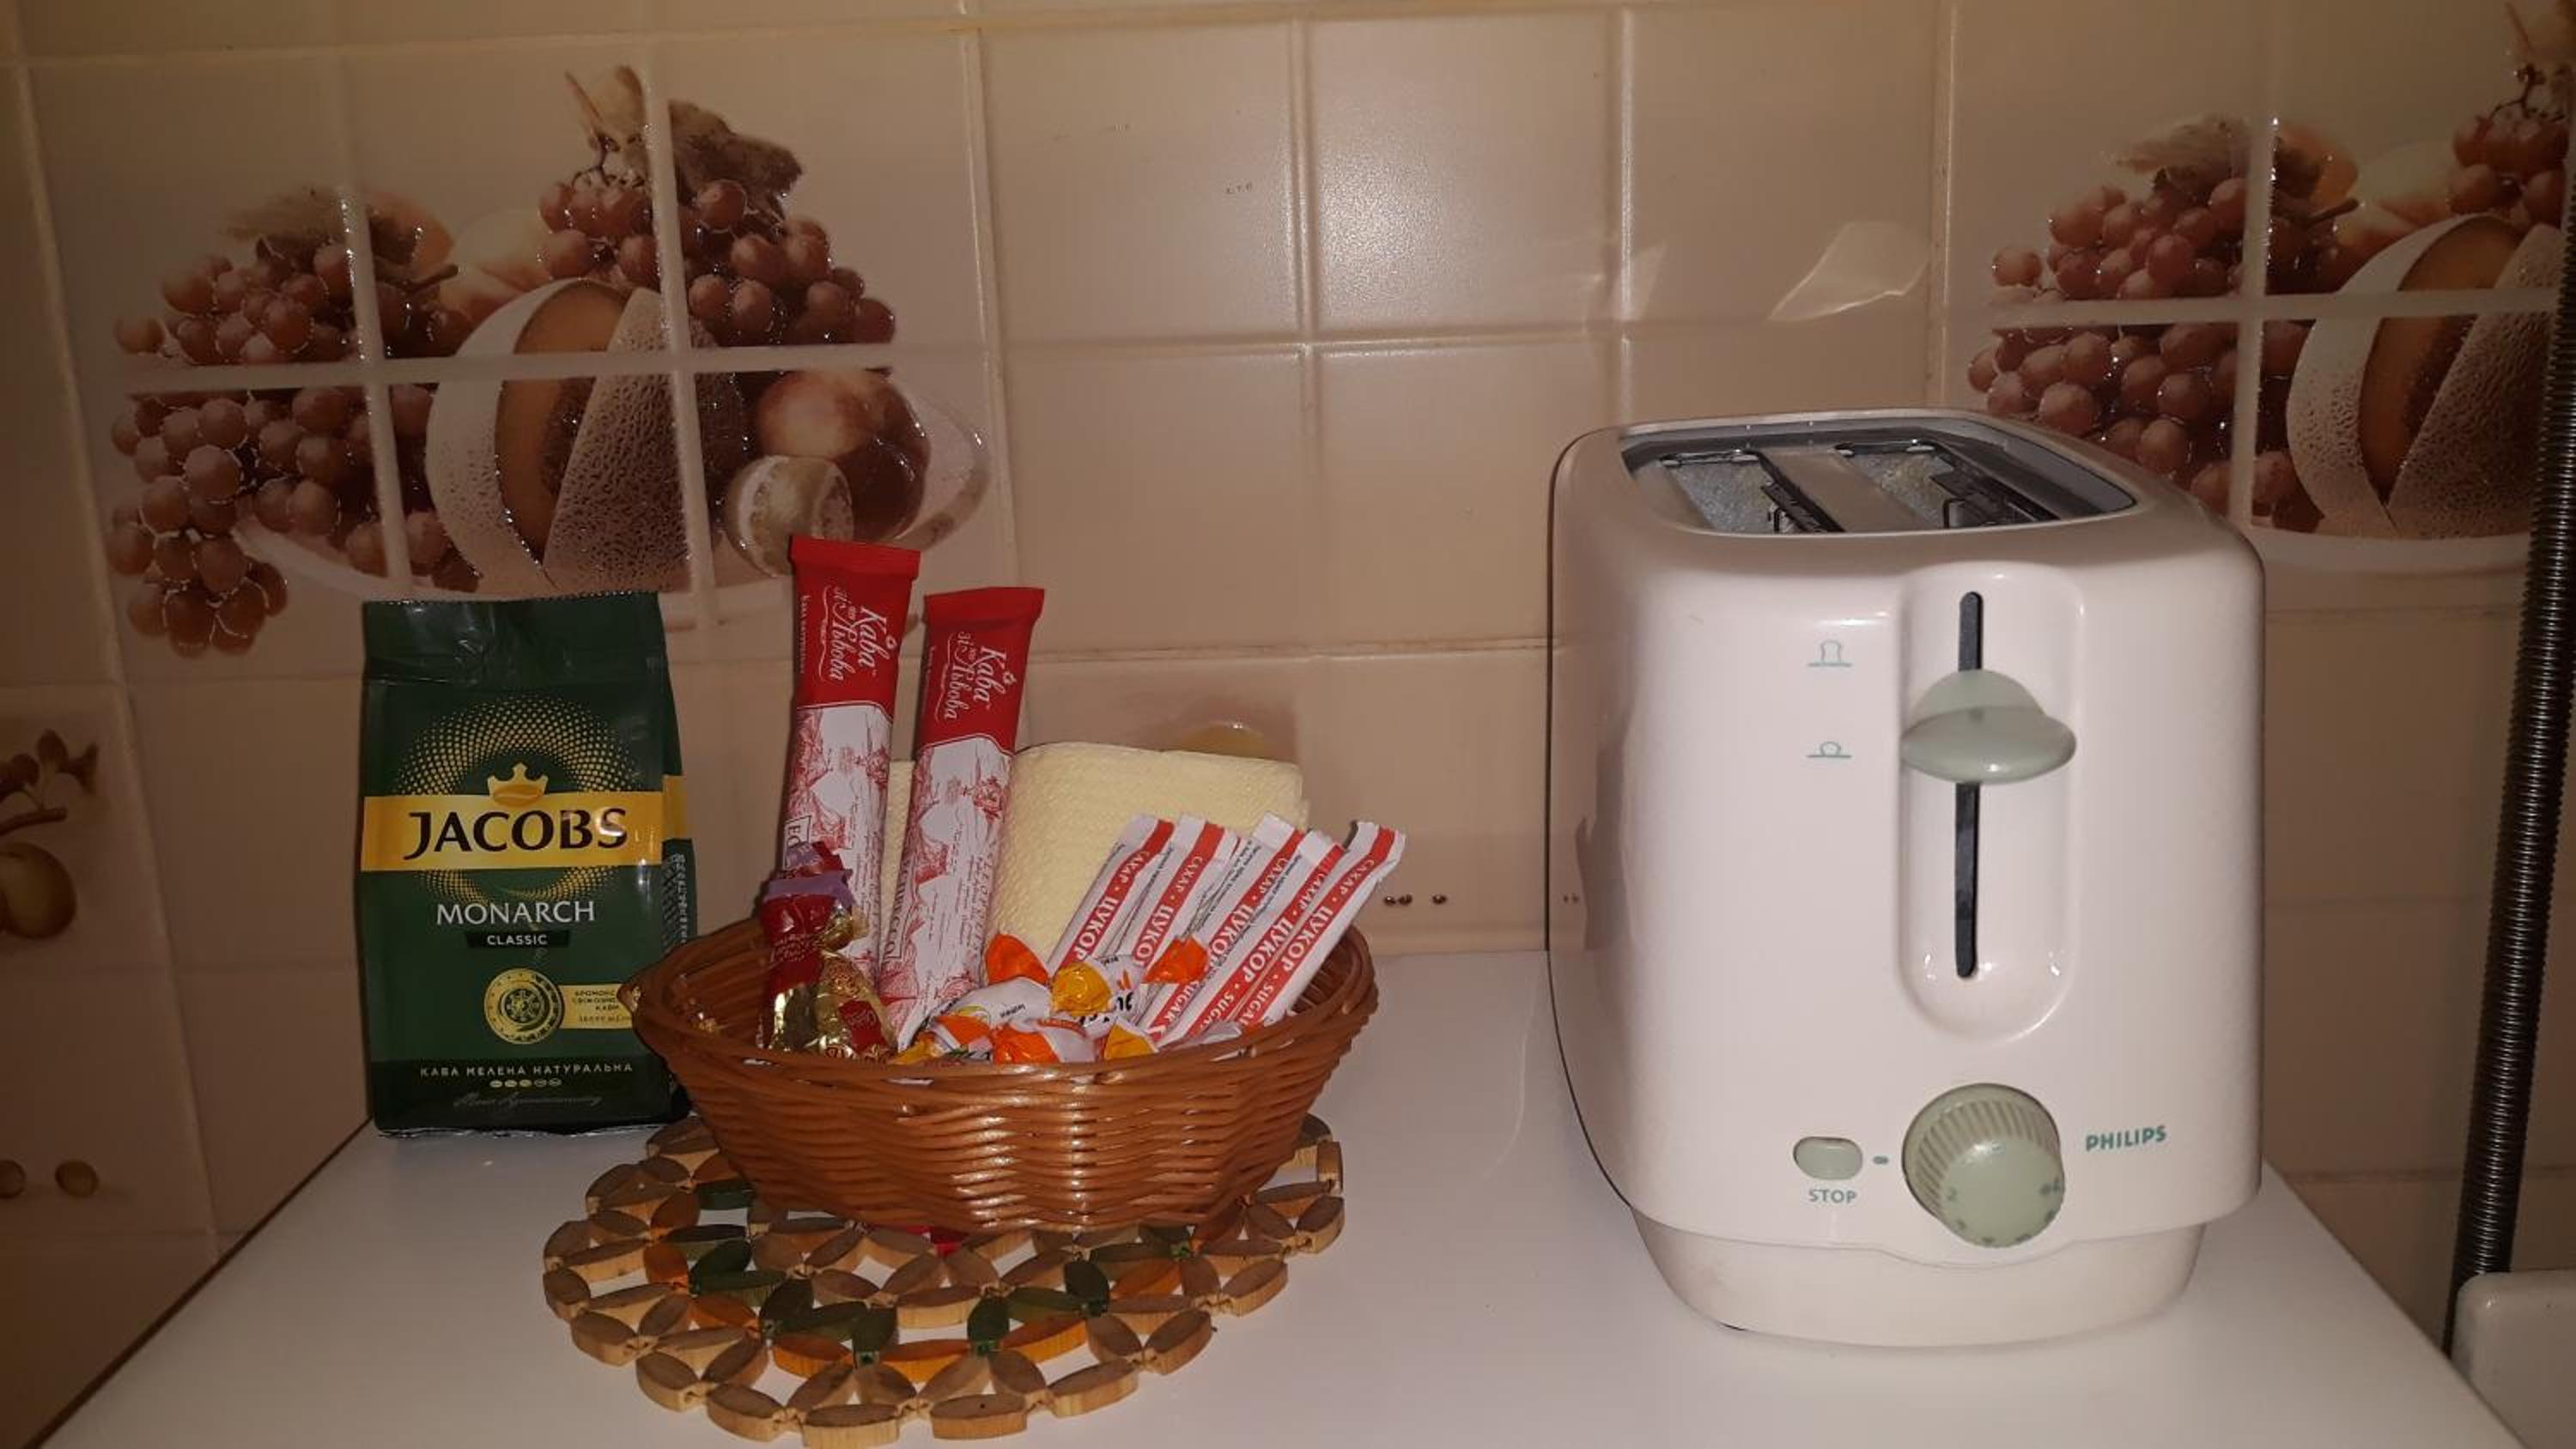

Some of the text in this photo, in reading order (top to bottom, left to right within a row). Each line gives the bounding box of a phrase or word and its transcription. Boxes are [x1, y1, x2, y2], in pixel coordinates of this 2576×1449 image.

[404, 809, 628, 860] JACOBS
[436, 900, 595, 925] MONARCH
[487, 934, 548, 946] CLASSIC
[1244, 917, 1293, 983] ЦУКОР
[1283, 906, 1334, 972] ЦУКОР
[1200, 991, 1235, 1028] SUGA
[420, 1064, 633, 1076] КАВА МЕЛЕНА НАТУРАЛЬНА
[2086, 1125, 2167, 1151] PHILIPS
[1808, 1189, 1857, 1203] STOP
